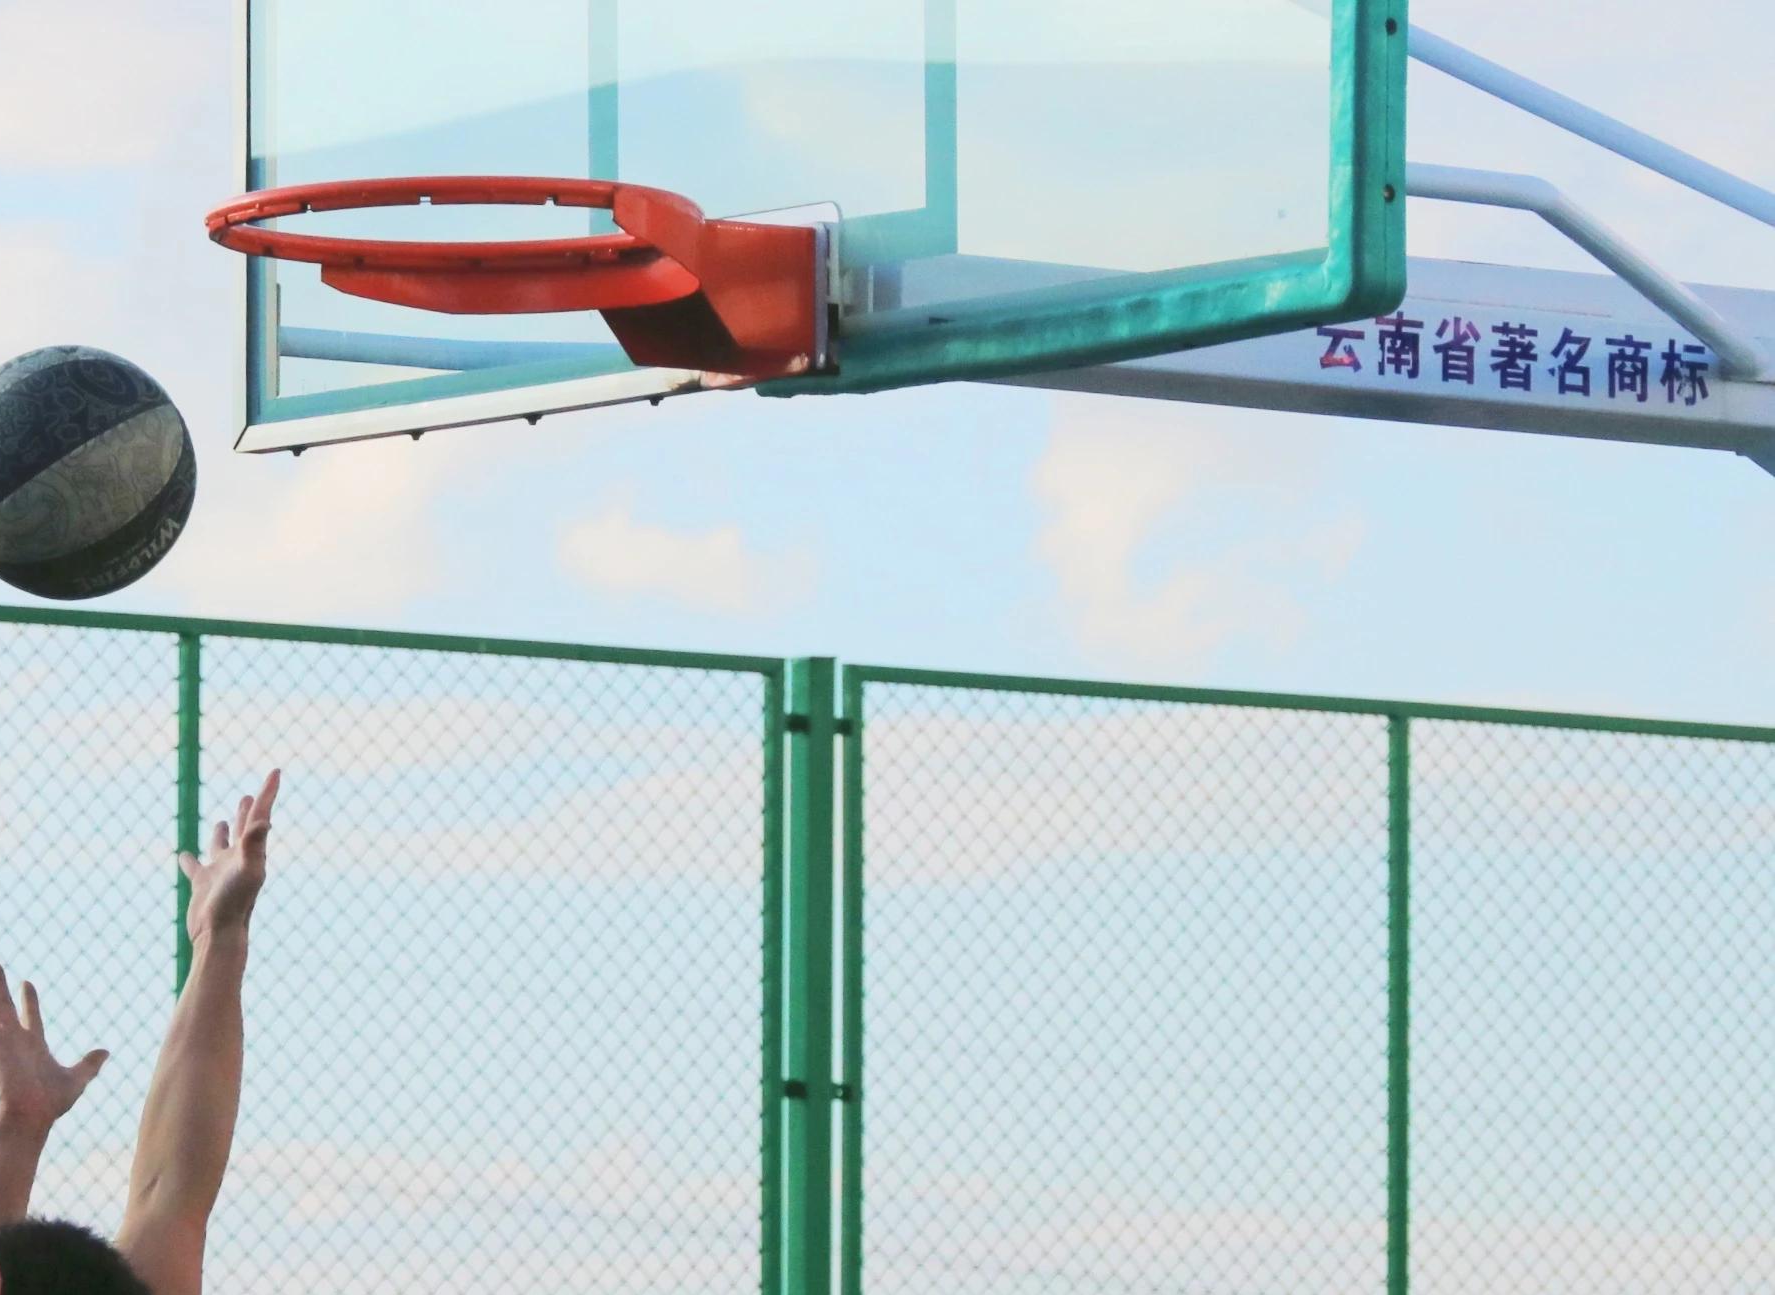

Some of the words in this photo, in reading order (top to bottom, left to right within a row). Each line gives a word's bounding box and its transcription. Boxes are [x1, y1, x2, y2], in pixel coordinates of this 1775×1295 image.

[1316, 311, 1710, 406] 云南省著名商标
